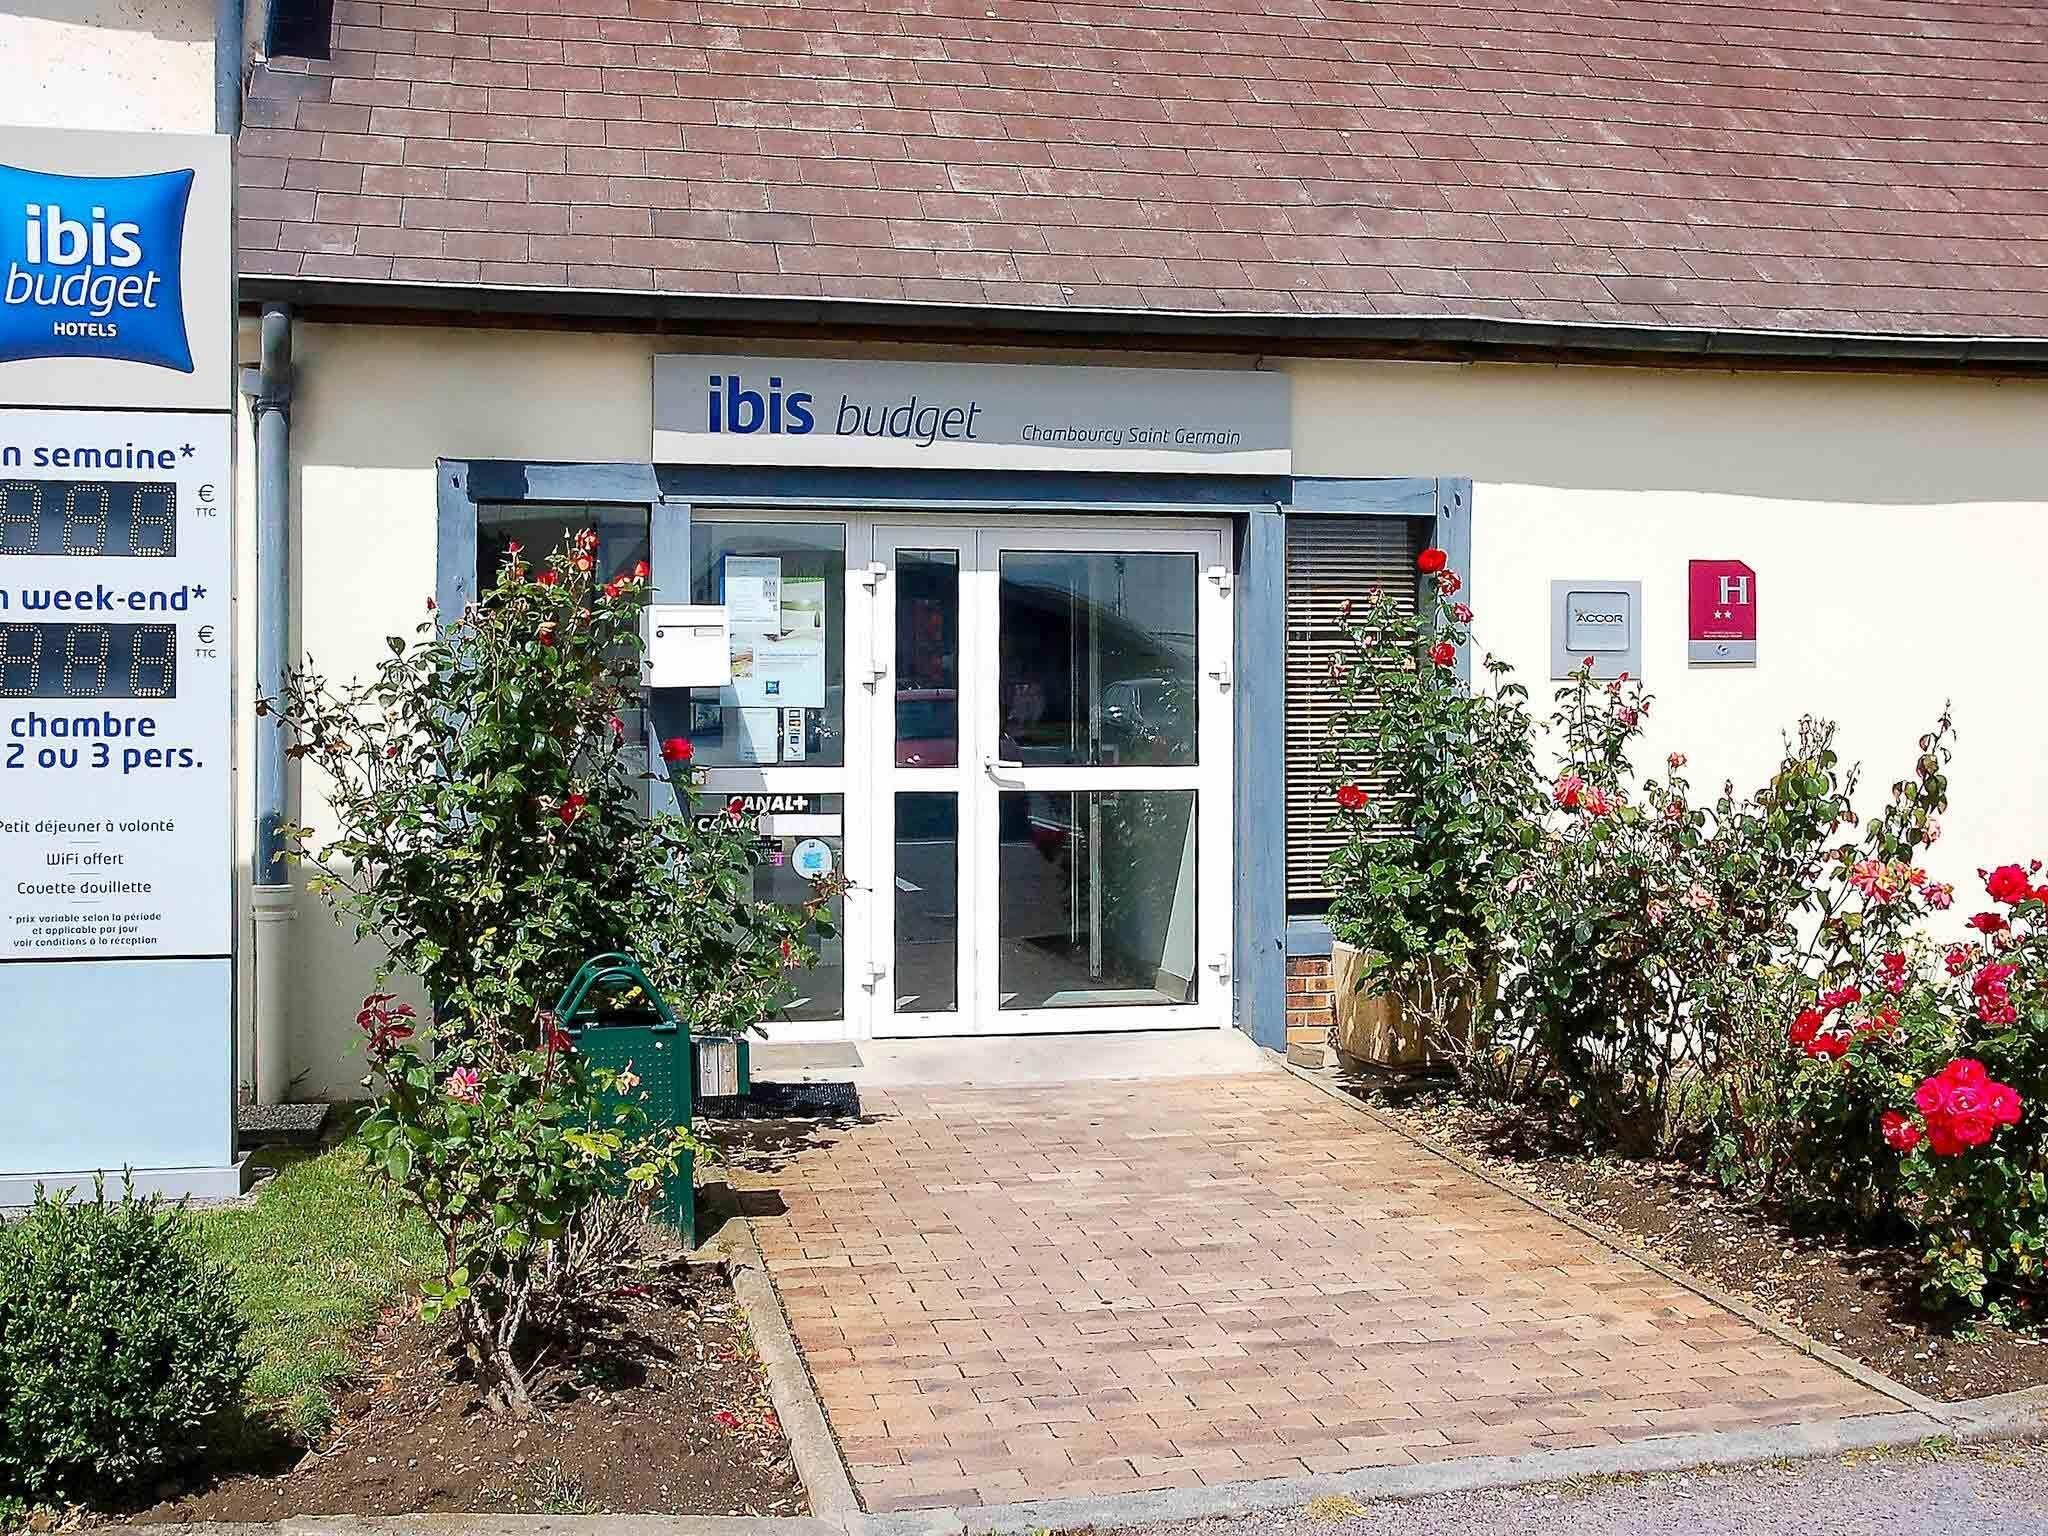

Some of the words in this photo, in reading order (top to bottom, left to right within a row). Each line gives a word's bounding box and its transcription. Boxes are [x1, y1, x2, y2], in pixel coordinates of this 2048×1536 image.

[25, 203, 142, 267] ibis
[4, 262, 161, 317] budget
[53, 322, 117, 337] HOTELS
[708, 375, 815, 434] ibis
[835, 394, 982, 447] budget
[1021, 425, 1123, 446] Chambourcy
[1127, 427, 1170, 444] Saint
[1174, 428, 1241, 445] Germain
[196, 507, 216, 517] TTC
[1719, 576, 1750, 605] H
[1576, 614, 1624, 624] ACCOR
[196, 648, 216, 658] TTC
[11, 711, 156, 738] chambre
[6, 743, 25, 768] 2
[38, 748, 78, 768] ou
[92, 743, 110, 768] 3
[123, 748, 203, 774] pers.
[35, 820, 100, 835] déjeuner
[106, 820, 113, 832] à
[119, 819, 175, 832] volonté
[46, 853, 79, 865] WiFi
[84, 853, 124, 865] offert
[17, 882, 76, 894] Couette
[80, 881, 152, 894] douillette
[16, 914, 35, 924] prix
[39, 913, 80, 923] variable
[83, 913, 110, 922] selon
[124, 912, 162, 922] période
[46, 925, 97, 935] applicable
[119, 925, 138, 934] jour
[35, 937, 87, 946] conditions
[110, 935, 157, 946] réception
